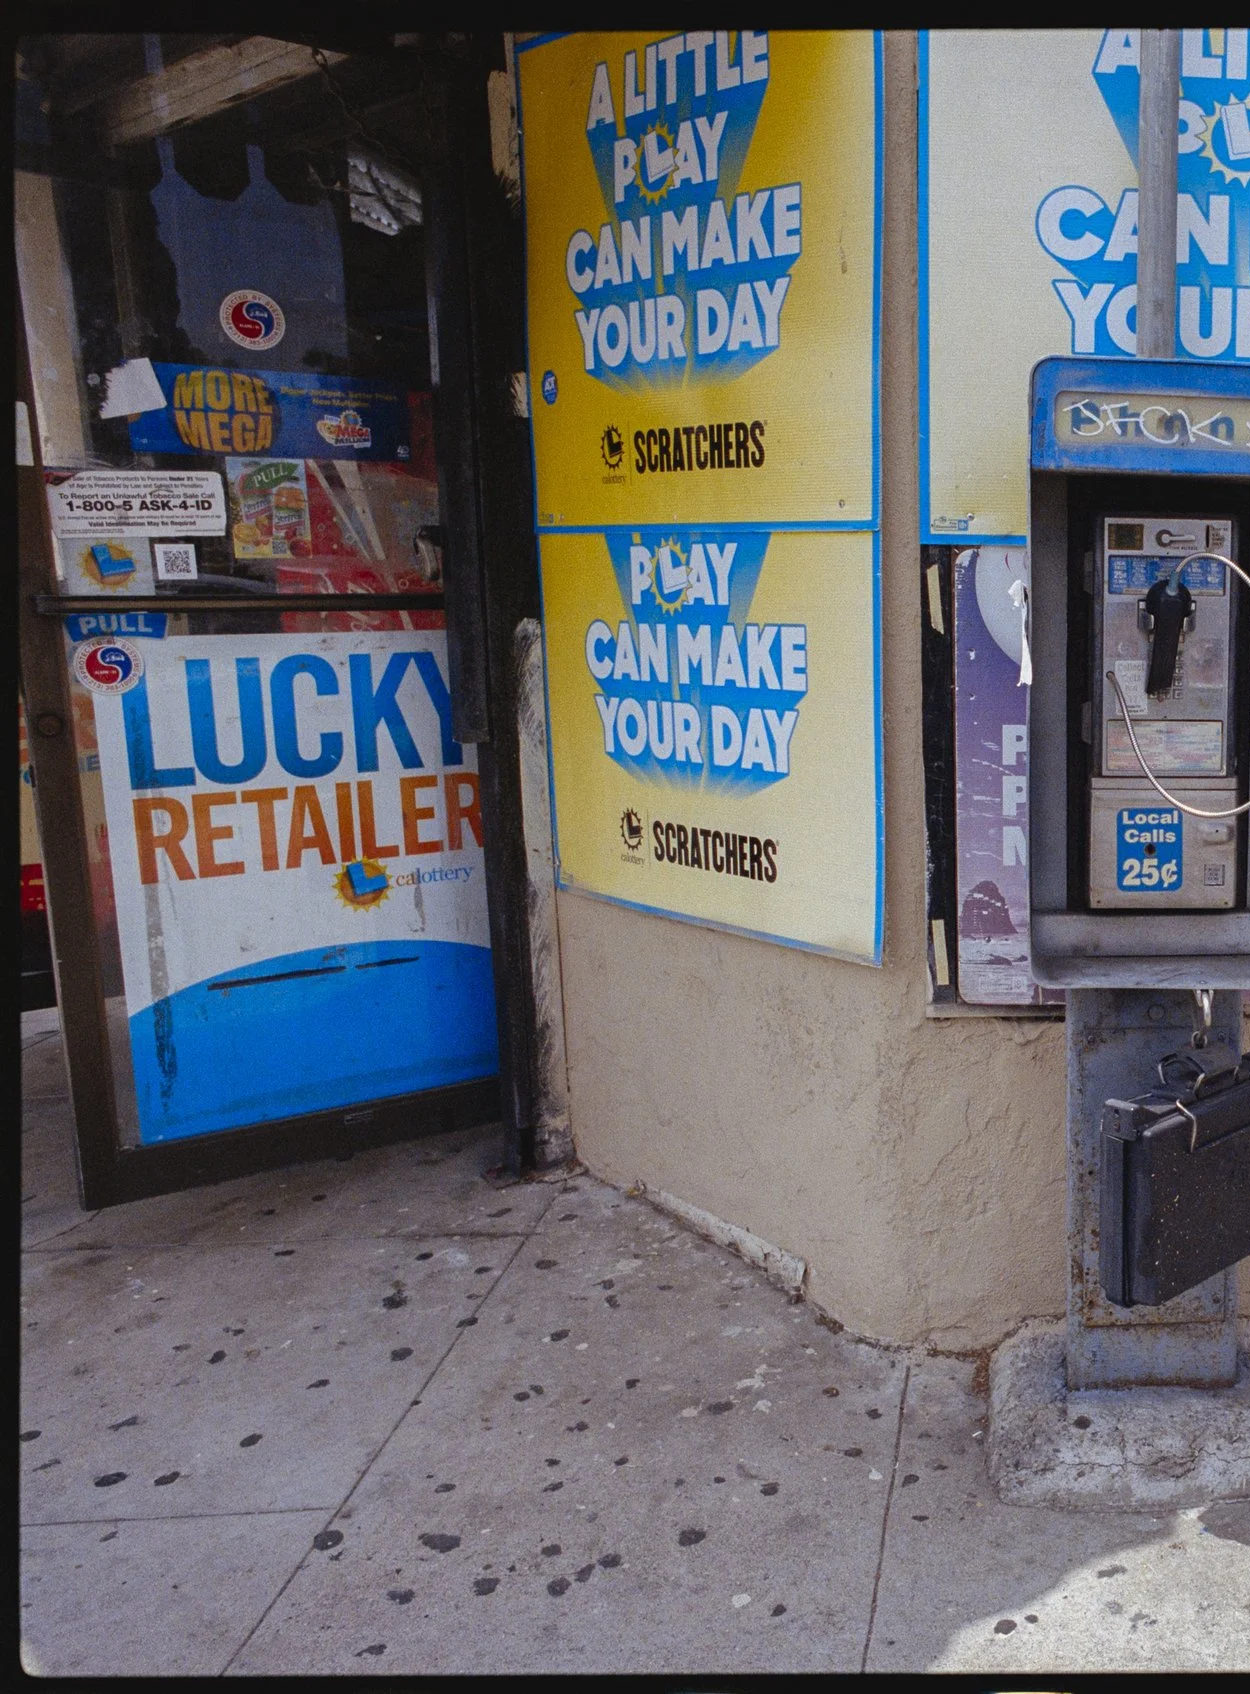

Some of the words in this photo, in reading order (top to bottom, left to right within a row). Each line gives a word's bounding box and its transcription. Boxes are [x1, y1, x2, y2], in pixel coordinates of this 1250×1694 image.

[588, 63, 618, 129] A
[624, 31, 770, 118] LITTLE
[614, 111, 729, 202] PLAY
[566, 216, 652, 293] CAN
[662, 183, 803, 273] MAKE
[1036, 185, 1231, 266] CAN
[575, 295, 688, 370] YOUR
[699, 274, 792, 356] DAY
[174, 370, 272, 413] MORE
[175, 410, 272, 453] MEGA
[253, 462, 288, 487] PULL
[66, 500, 133, 512] 1-800-5
[139, 500, 213, 512] ASK-4-ID
[71, 493, 99, 501] Report
[113, 492, 147, 500] Unlawful
[170, 520, 197, 528] Required
[630, 539, 738, 606] PLAY
[79, 614, 153, 635] PULL
[585, 619, 668, 684] CAN
[677, 623, 808, 692] MAKE
[121, 651, 464, 790] LUCKY
[593, 694, 704, 764] YOUR
[711, 705, 799, 775] DAY
[132, 772, 484, 885] RETAILER
[1122, 810, 1180, 825] Local
[1124, 829, 1177, 843] Calls
[396, 866, 473, 887] calottery
[1122, 858, 1178, 888] 25¢
